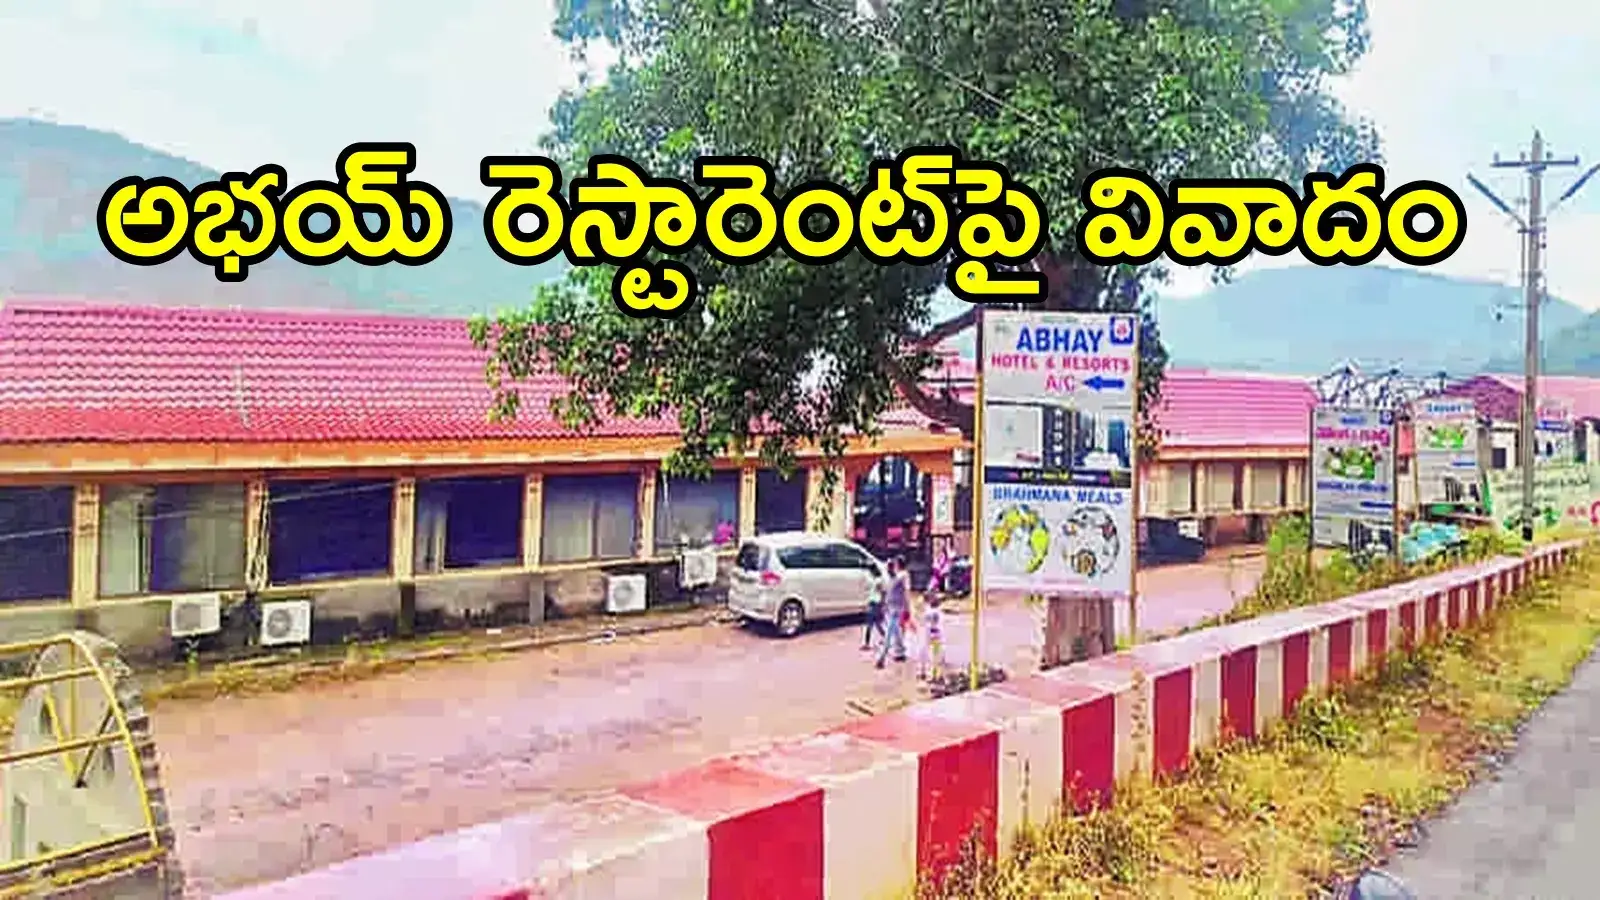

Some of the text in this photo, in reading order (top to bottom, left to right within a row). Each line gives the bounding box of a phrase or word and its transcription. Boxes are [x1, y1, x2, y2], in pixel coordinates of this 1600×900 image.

[1016, 326, 1103, 352] ABHAY
[991, 353, 1038, 370] HOTEL
[1062, 355, 1130, 371] RESORTS
[1045, 375, 1076, 392] A/C
[1076, 489, 1123, 504] MEALS
